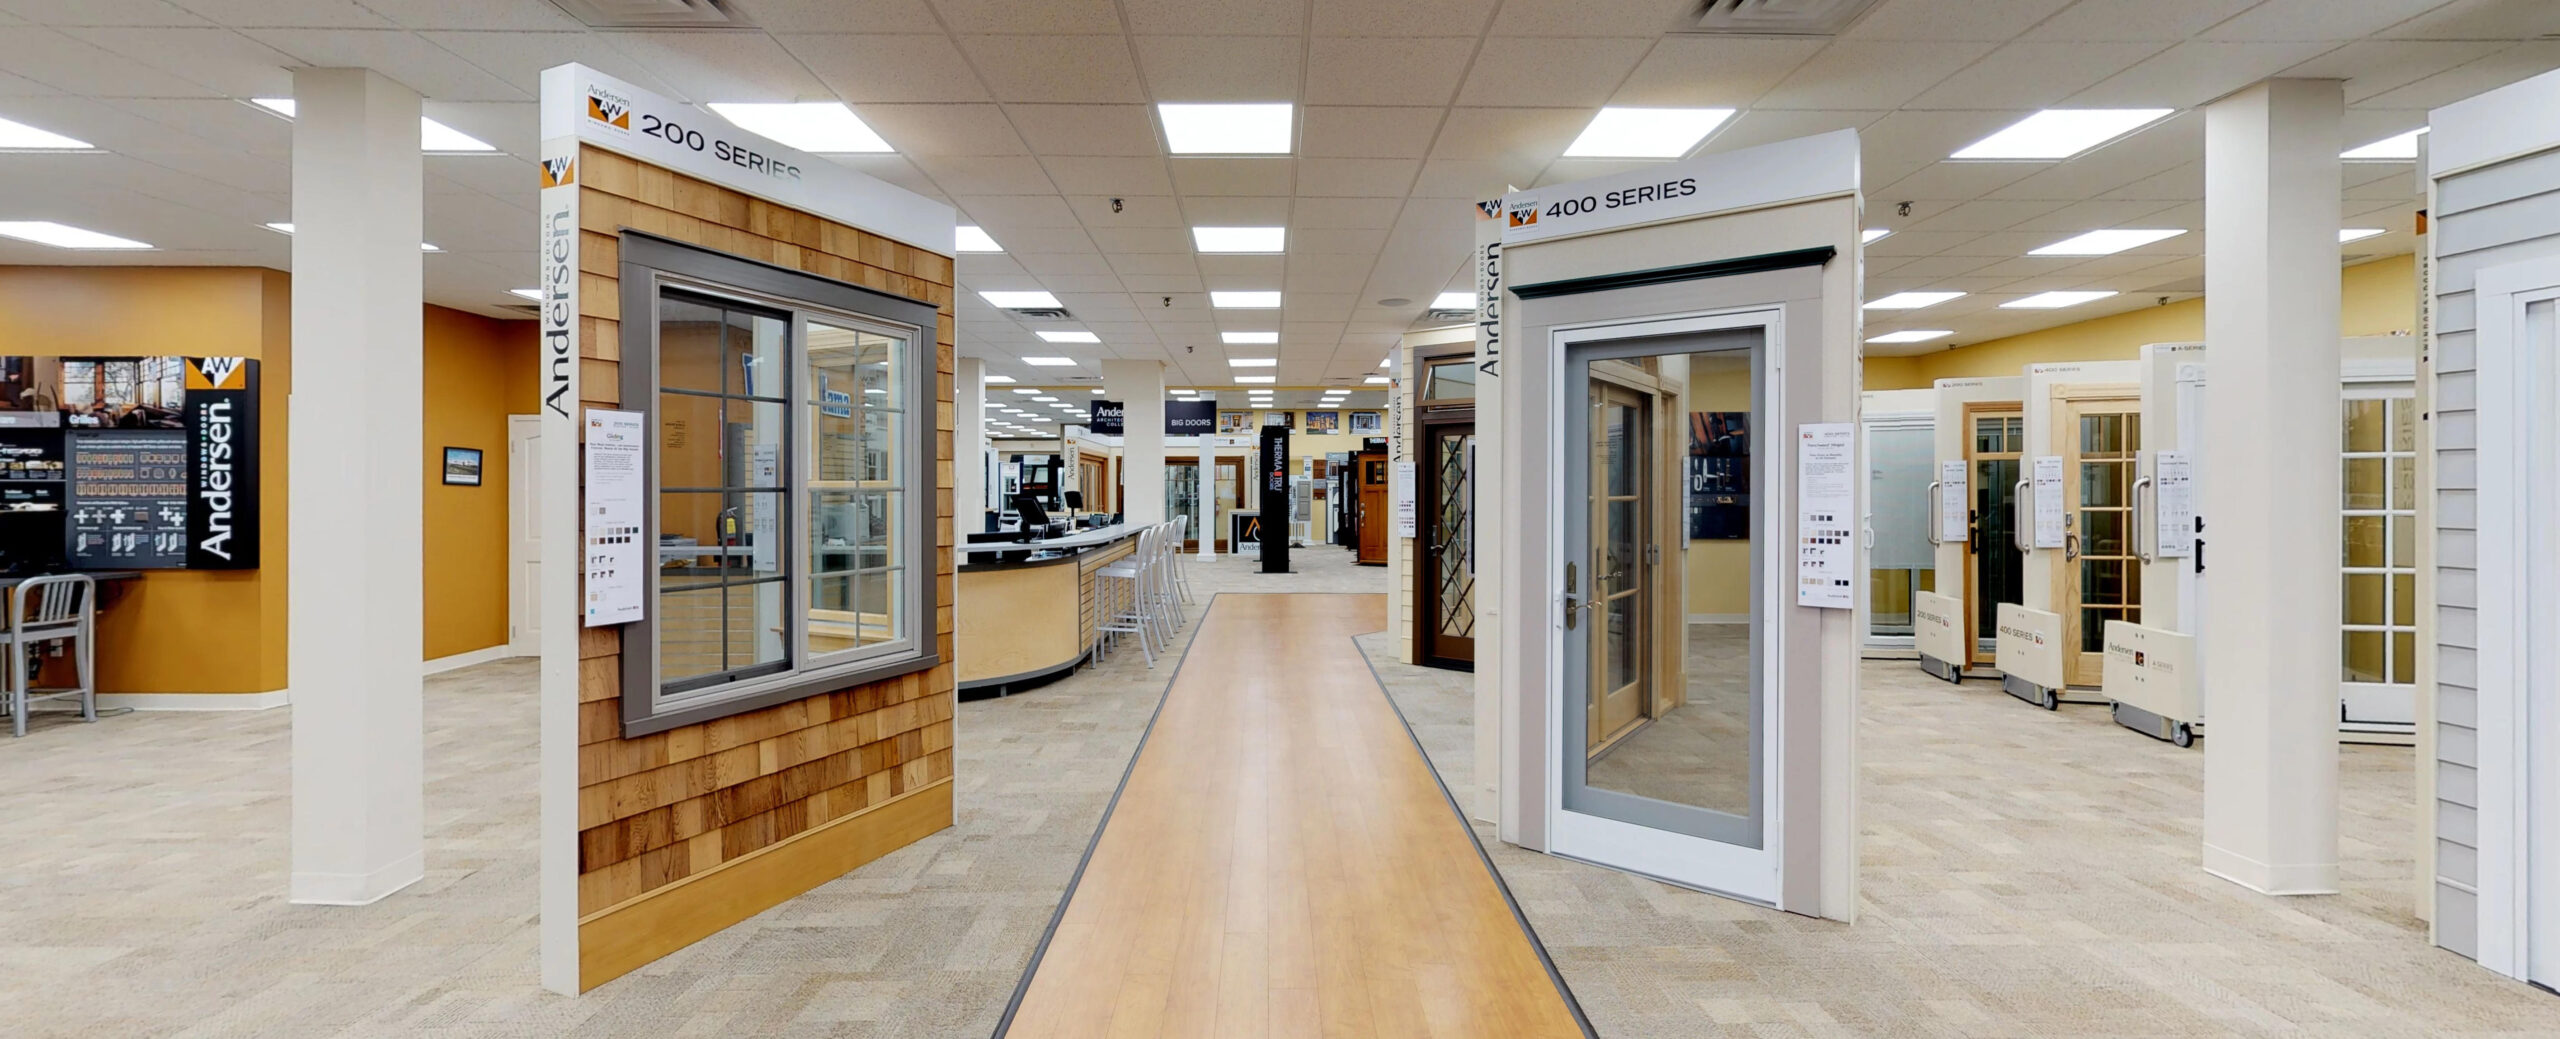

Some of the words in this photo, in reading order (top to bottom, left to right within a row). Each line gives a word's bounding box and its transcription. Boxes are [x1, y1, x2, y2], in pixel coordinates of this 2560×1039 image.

[587, 83, 630, 107] Andersen
[642, 114, 705, 152] 200
[714, 140, 801, 181] SERIES
[1510, 201, 1538, 210] Andersen
[1546, 196, 1597, 218] 400
[1605, 178, 1696, 209] SERIES
[546, 209, 570, 420] Andersen
[1480, 241, 1501, 378] Andersen
[201, 398, 232, 560] Andersen
[1917, 610, 1927, 619] 200
[1927, 612, 1942, 624] SERIES
[2000, 625, 2012, 636] 400
[2013, 629, 2033, 641] SERIES
[2108, 642, 2134, 656] Andersen
